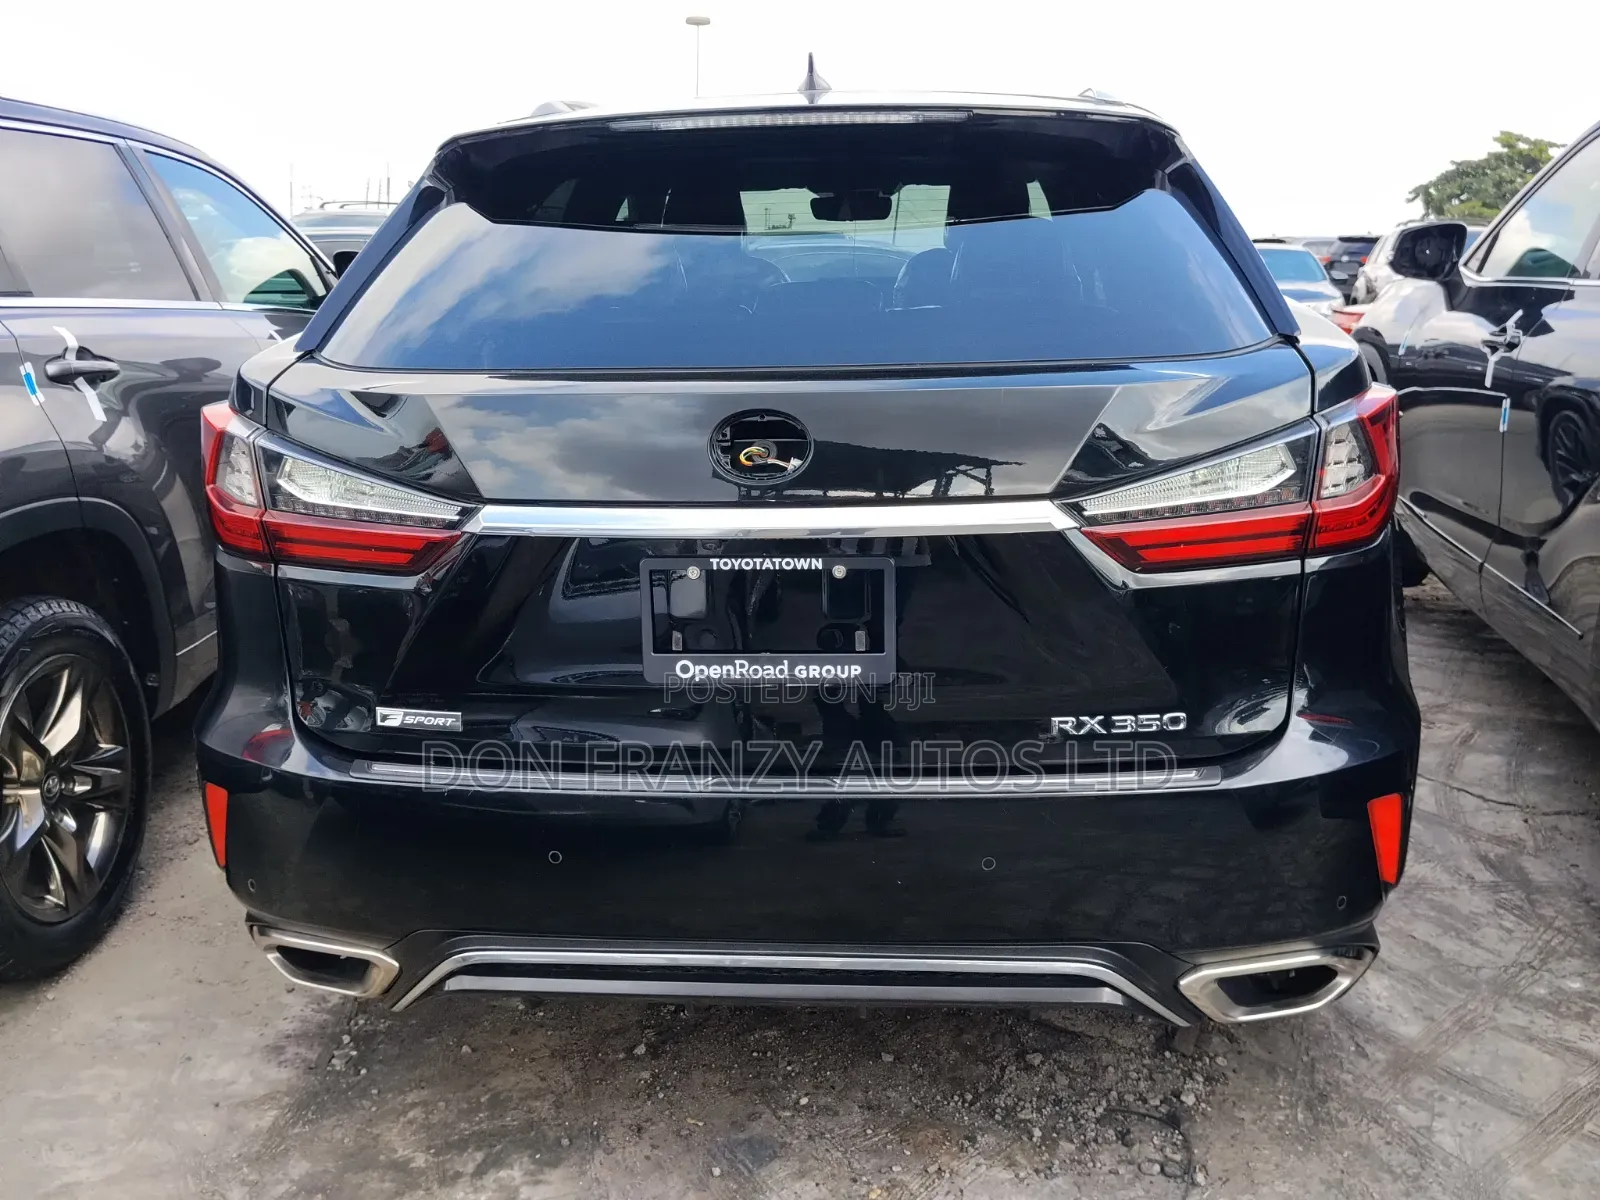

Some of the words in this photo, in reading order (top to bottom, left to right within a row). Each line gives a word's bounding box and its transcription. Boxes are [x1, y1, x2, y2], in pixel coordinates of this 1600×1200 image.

[710, 558, 823, 570] TOYOTATOWN
[675, 659, 789, 682] OpenRoad
[794, 664, 862, 679] GROUP
[403, 715, 456, 727] SPORT
[1051, 715, 1107, 735] RX
[1111, 712, 1187, 733] 350
